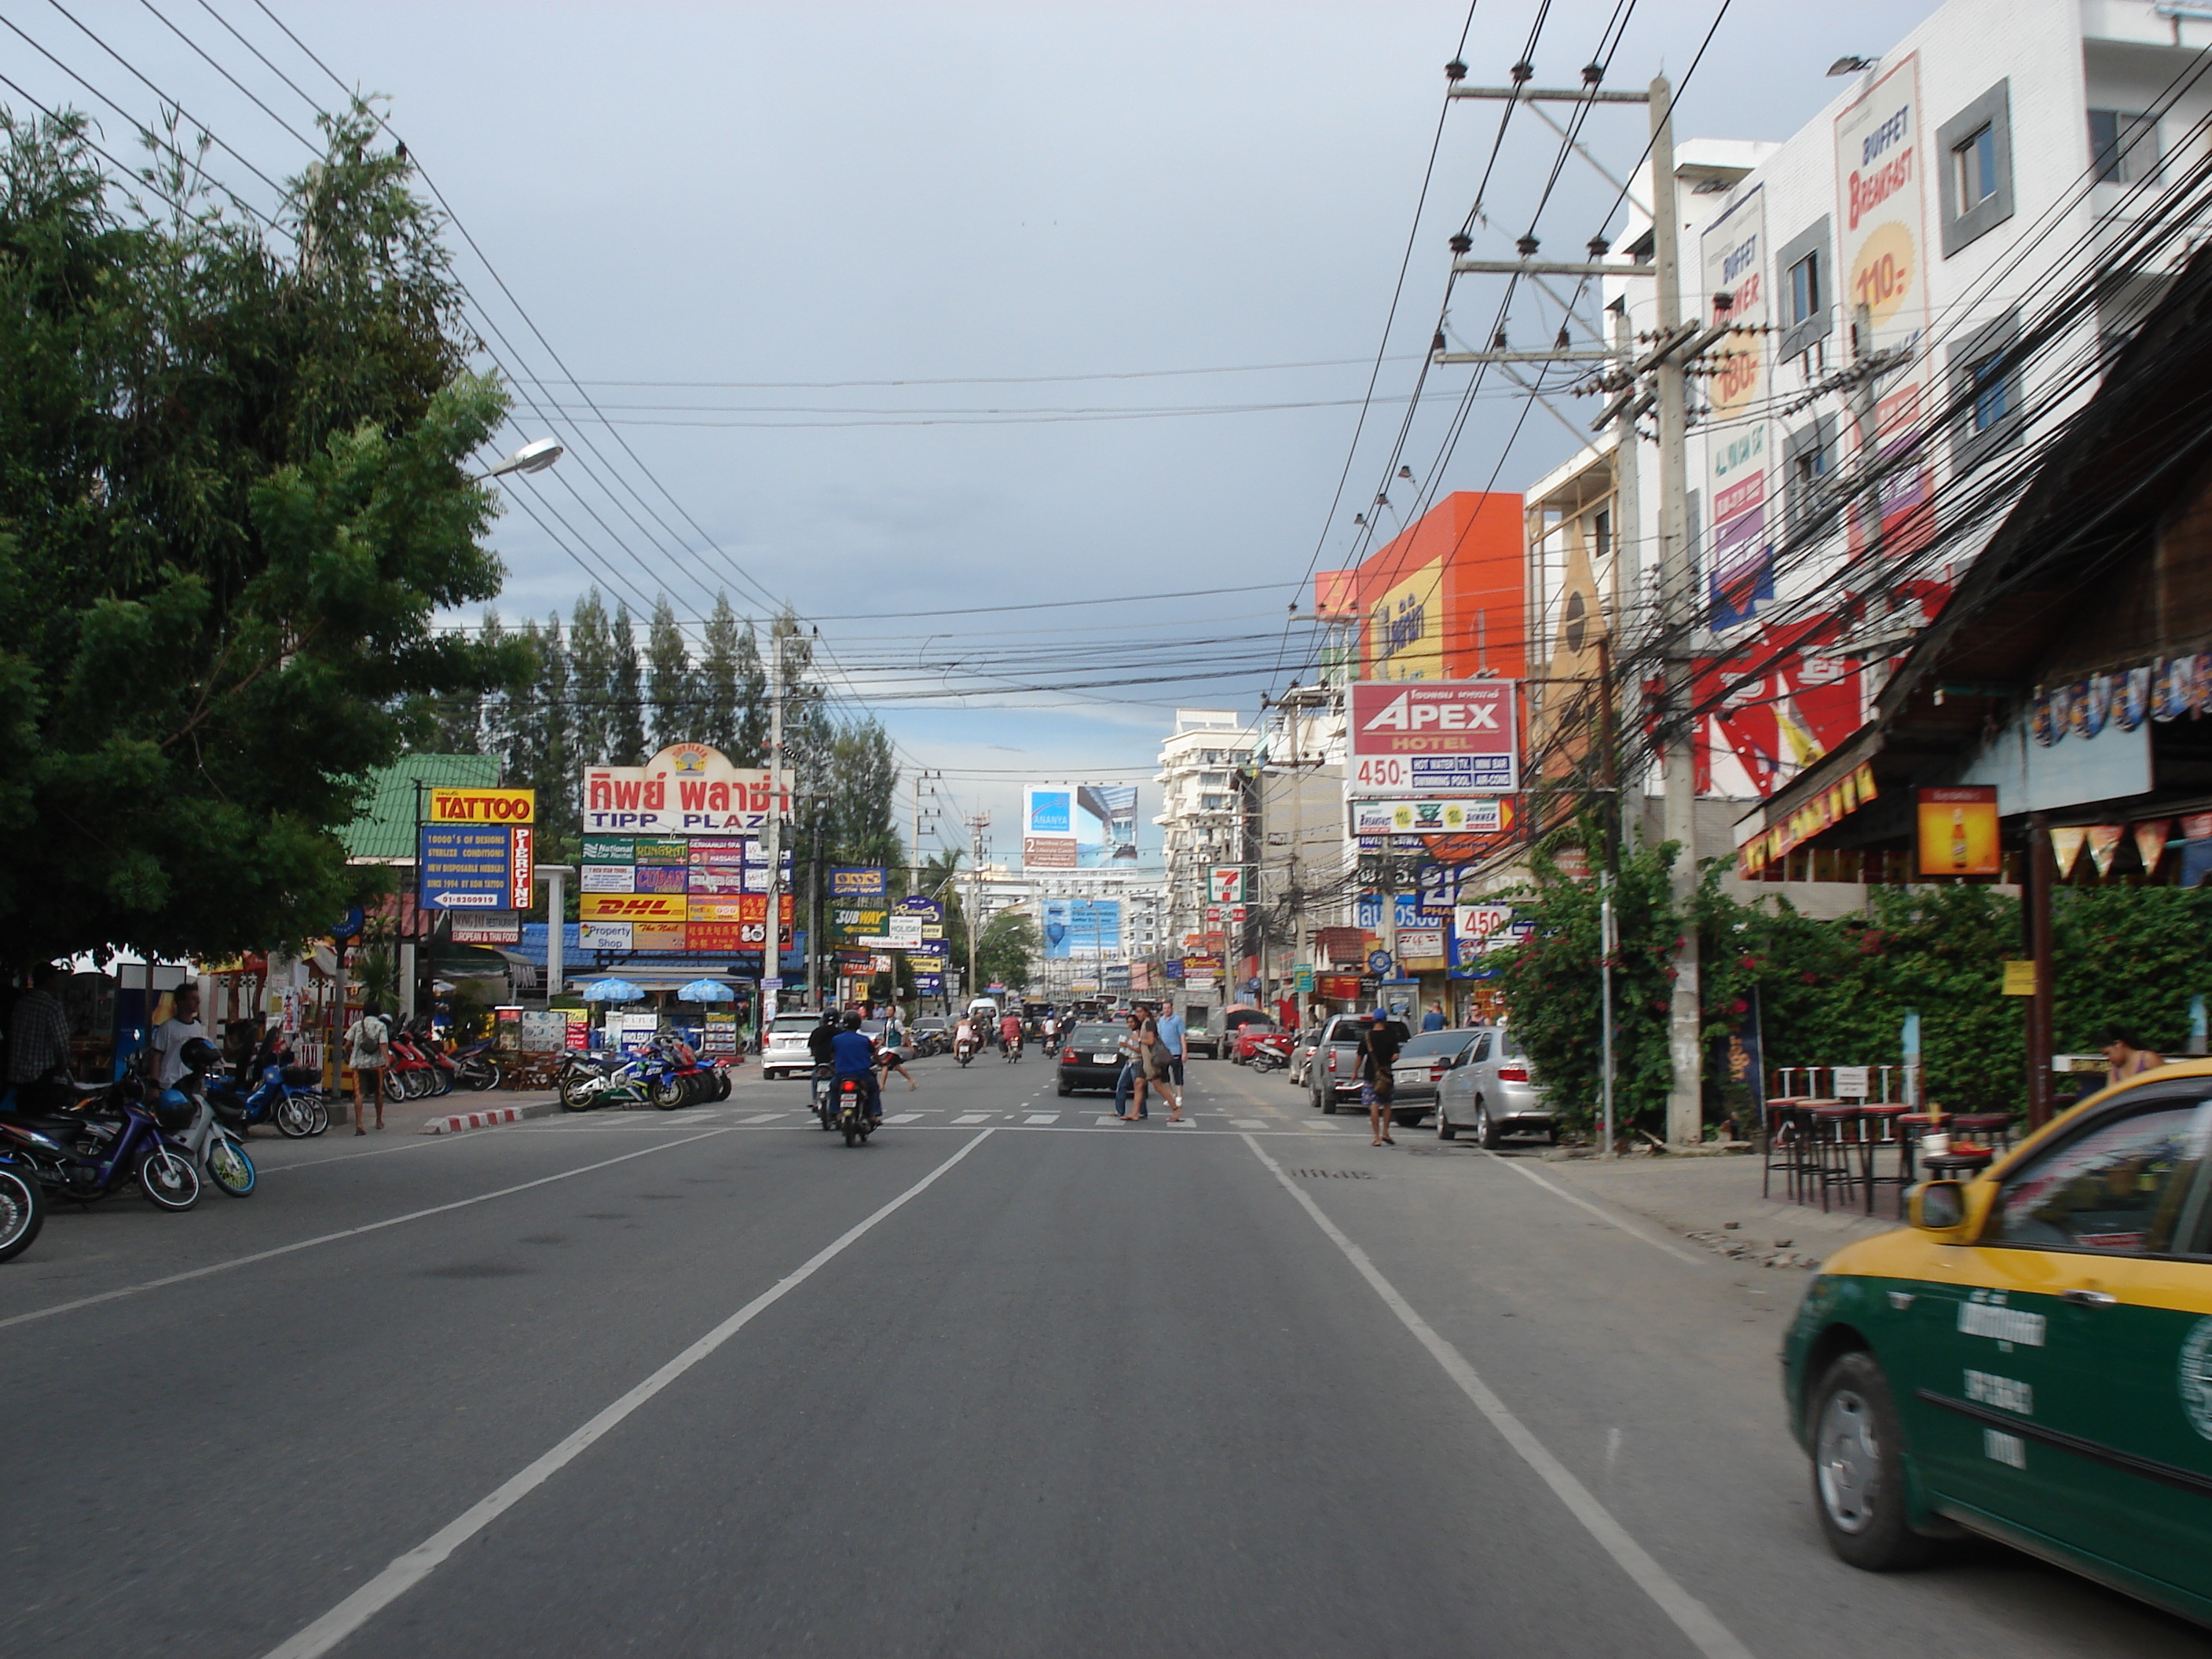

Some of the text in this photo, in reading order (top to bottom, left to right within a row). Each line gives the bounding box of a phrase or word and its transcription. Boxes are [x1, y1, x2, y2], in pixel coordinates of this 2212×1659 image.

[1862, 104, 1909, 167] BUFFET
[1848, 146, 1913, 233] BREAKFAST
[1723, 233, 1756, 286] BUFFET
[1362, 690, 1500, 731] APEX
[1391, 737, 1474, 750] HOTEL
[1413, 759, 1455, 770] HOT WATER
[1492, 758, 1508, 769] BAR
[1413, 775, 1471, 786] SWIMMING POOL
[591, 771, 667, 811] ทิพย์
[436, 797, 530, 819] TATTOO
[591, 813, 657, 828] TIPP
[1034, 816, 1068, 825] ANANYA
[463, 836, 473, 844] OF
[475, 836, 505, 844] DESIGNS
[1026, 839, 1035, 853] 2
[599, 844, 634, 853] National
[427, 864, 505, 873] NEW DISPOSABLE NEEDLES
[515, 829, 529, 908] PIERCING
[461, 880, 469, 888] BY
[485, 880, 504, 889] TATTOO
[637, 870, 687, 888] CUBAN
[597, 899, 671, 915] DHL
[835, 910, 888, 925] SUBWAY
[1221, 910, 1232, 920] 24
[590, 926, 630, 937] Property
[657, 924, 679, 932] Nail
[452, 932, 518, 942] EUROPEAN & THAI FOOD
[598, 939, 622, 949] Shop
[301, 1045, 317, 1068] TAXI
